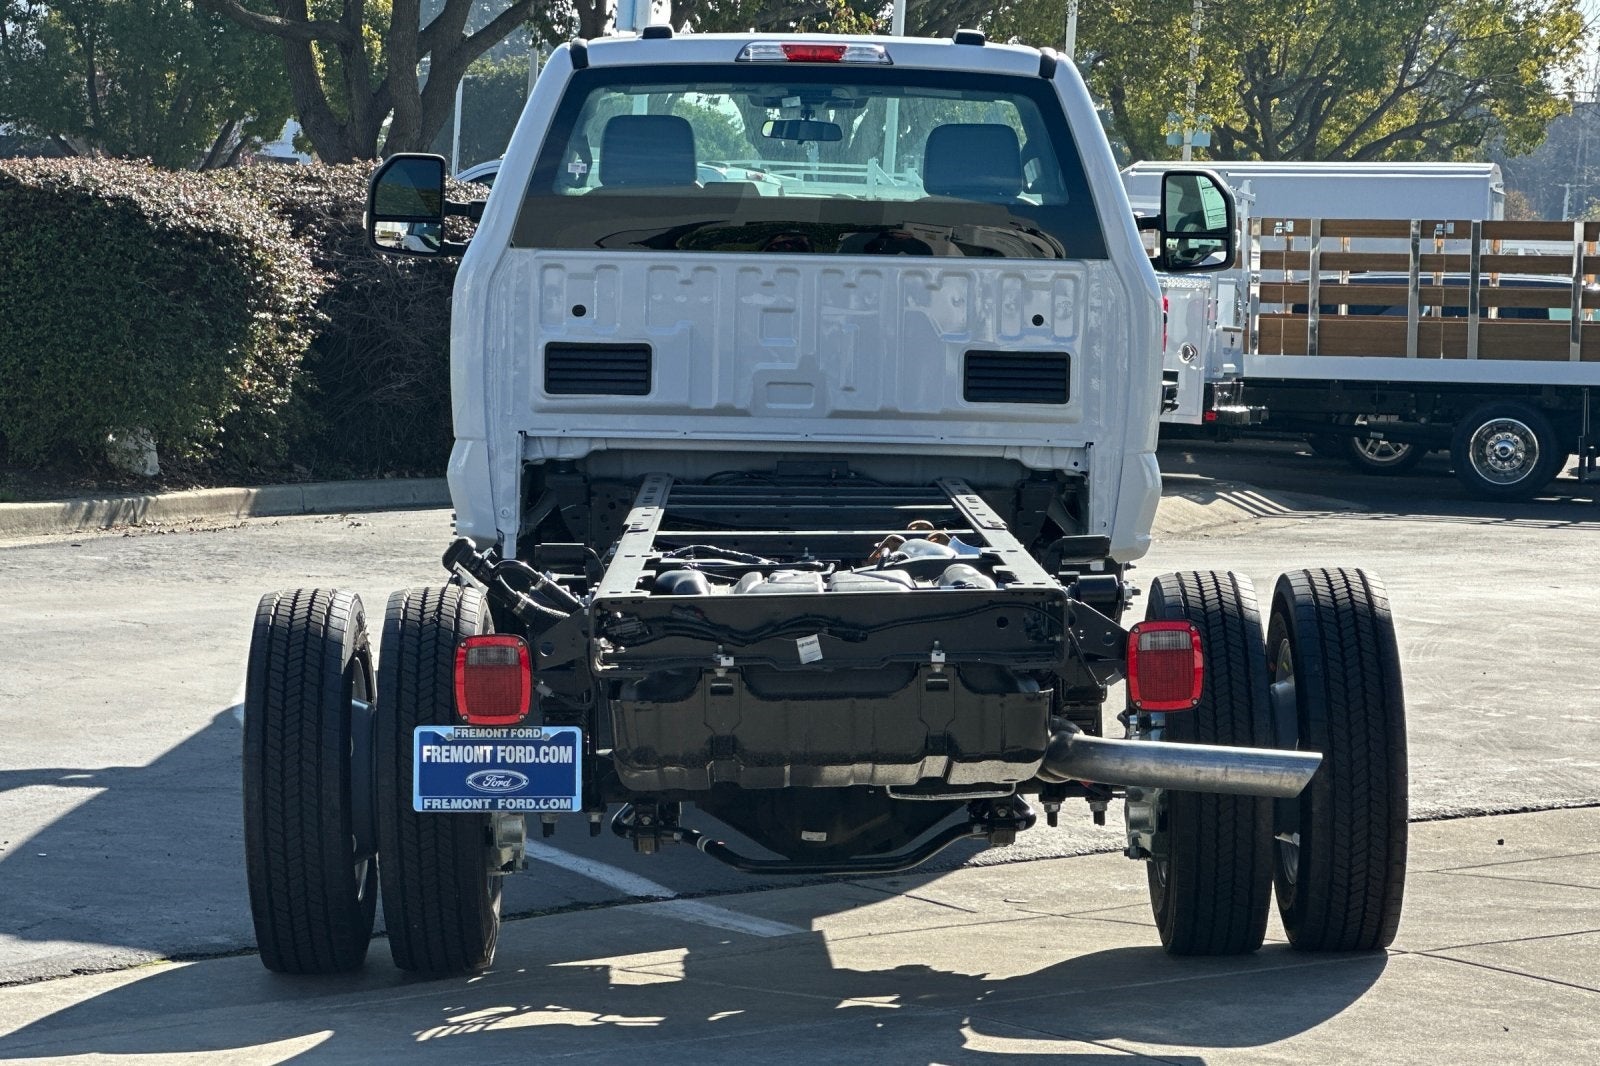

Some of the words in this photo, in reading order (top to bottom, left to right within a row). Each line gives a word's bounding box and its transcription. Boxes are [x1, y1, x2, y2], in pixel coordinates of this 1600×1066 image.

[454, 728, 508, 738] FREMONT
[510, 728, 541, 738] FORD
[422, 745, 493, 763] FREMONT
[497, 745, 573, 763] FORD.COM
[482, 775, 512, 787] Ford
[423, 798, 491, 809] FREMONT
[497, 798, 572, 809] FORD.COM
